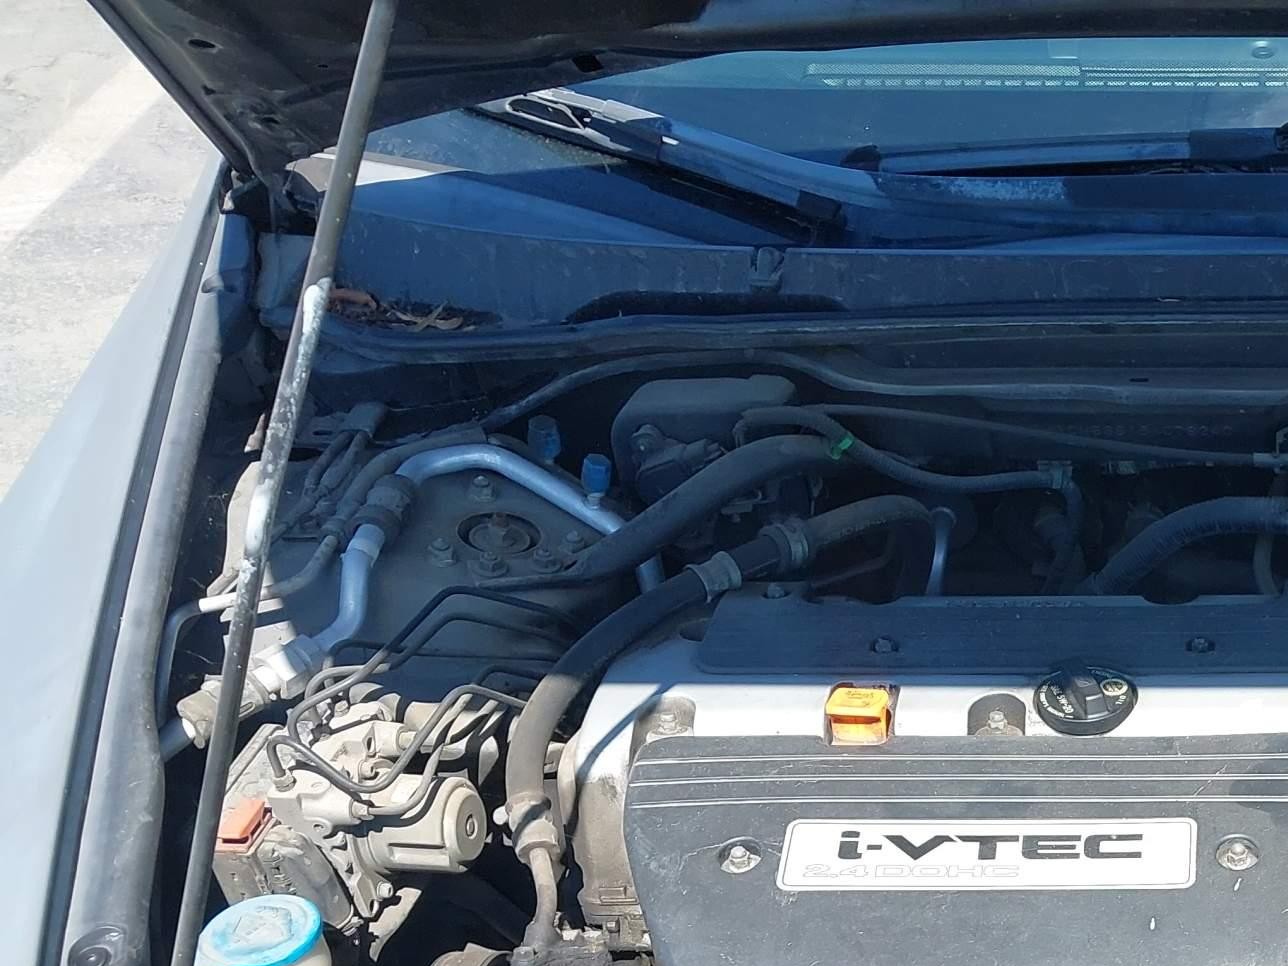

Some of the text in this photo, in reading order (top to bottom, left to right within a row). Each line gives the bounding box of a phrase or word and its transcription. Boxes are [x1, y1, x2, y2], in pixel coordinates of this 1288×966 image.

[838, 830, 1144, 861] i-VTEC
[802, 864, 1020, 878] 2.4 DOHC
